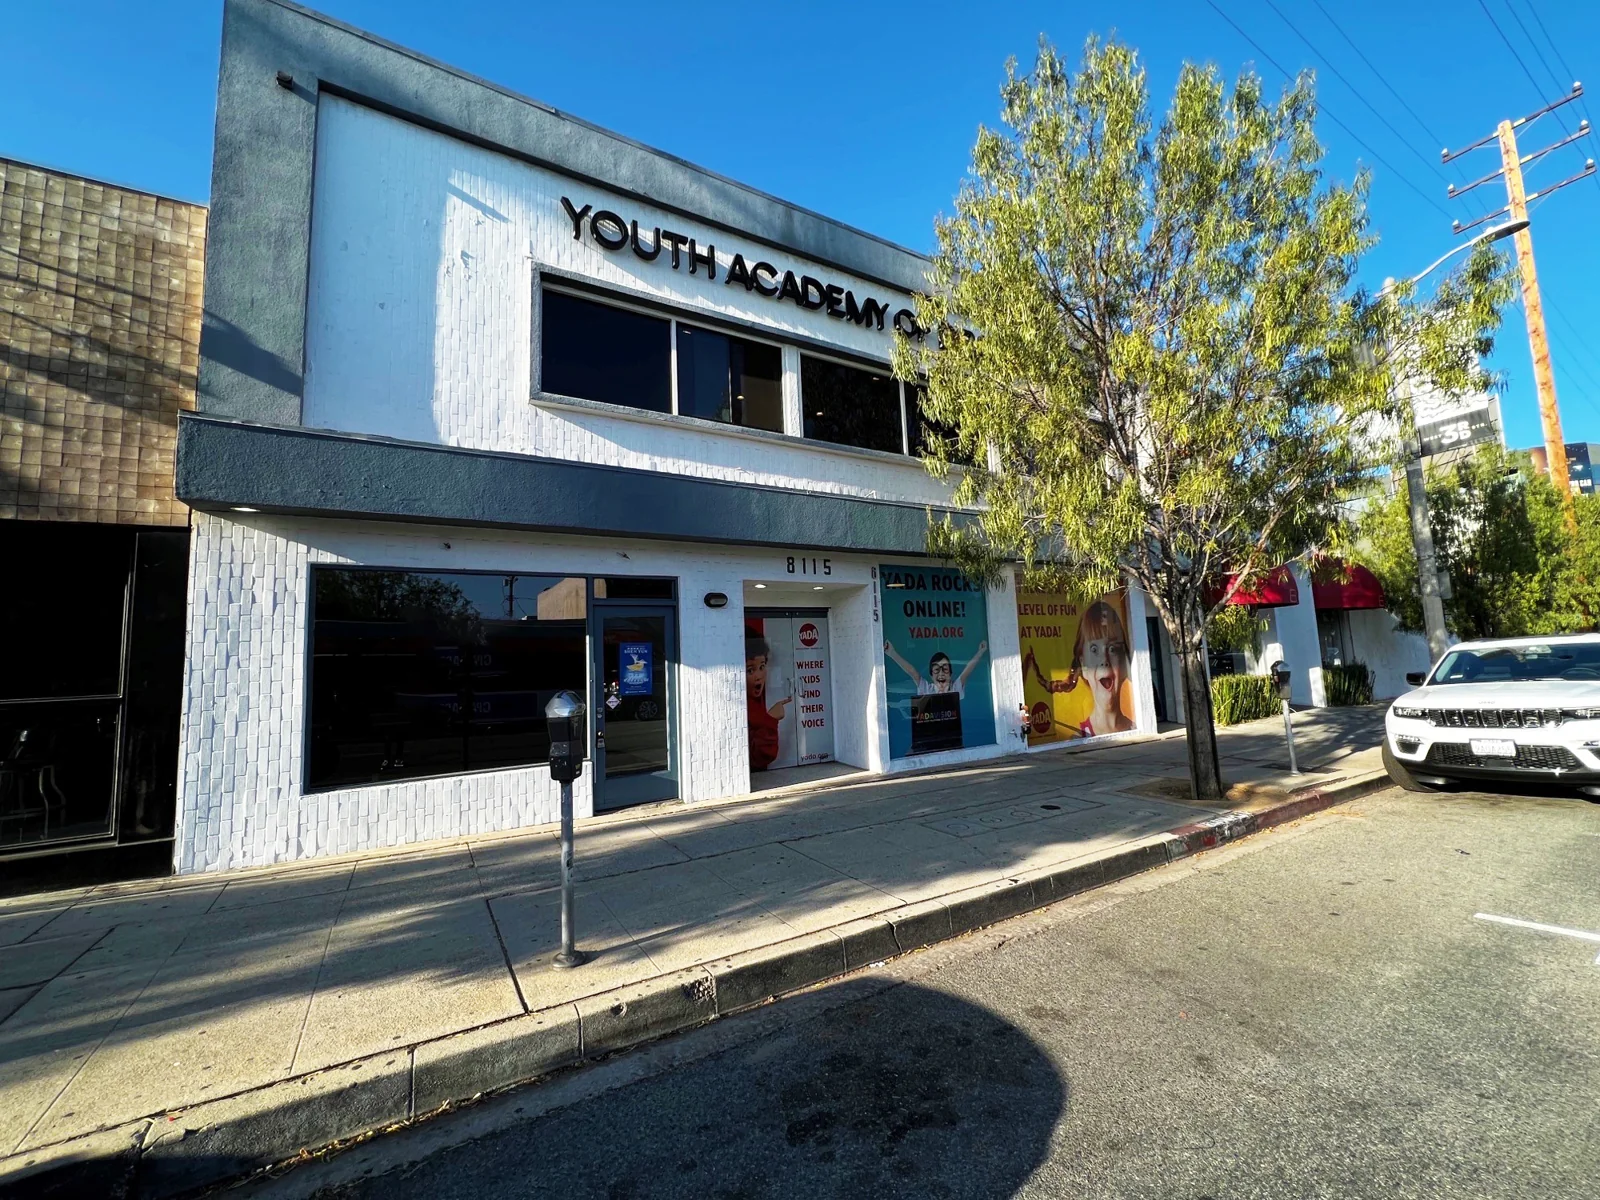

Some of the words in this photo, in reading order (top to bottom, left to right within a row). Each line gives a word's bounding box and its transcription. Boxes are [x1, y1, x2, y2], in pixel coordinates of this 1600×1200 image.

[560, 196, 716, 280] YOUTH
[724, 253, 890, 331] ACADEMY
[786, 556, 832, 576] 8115
[880, 571, 927, 591] YADA
[903, 600, 966, 618] ONLINE!
[1018, 603, 1046, 616] LEVEL
[1047, 604, 1059, 616] OF
[1060, 604, 1077, 616] FUN
[799, 629, 819, 640] YADA
[908, 626, 964, 639] YADA.ORG
[1020, 625, 1032, 639] AT
[1033, 625, 1062, 638] YADA!
[796, 660, 824, 670] WHERE
[800, 704, 824, 713] THEIR
[801, 718, 825, 728] VOICE
[1032, 709, 1051, 725] YADA
